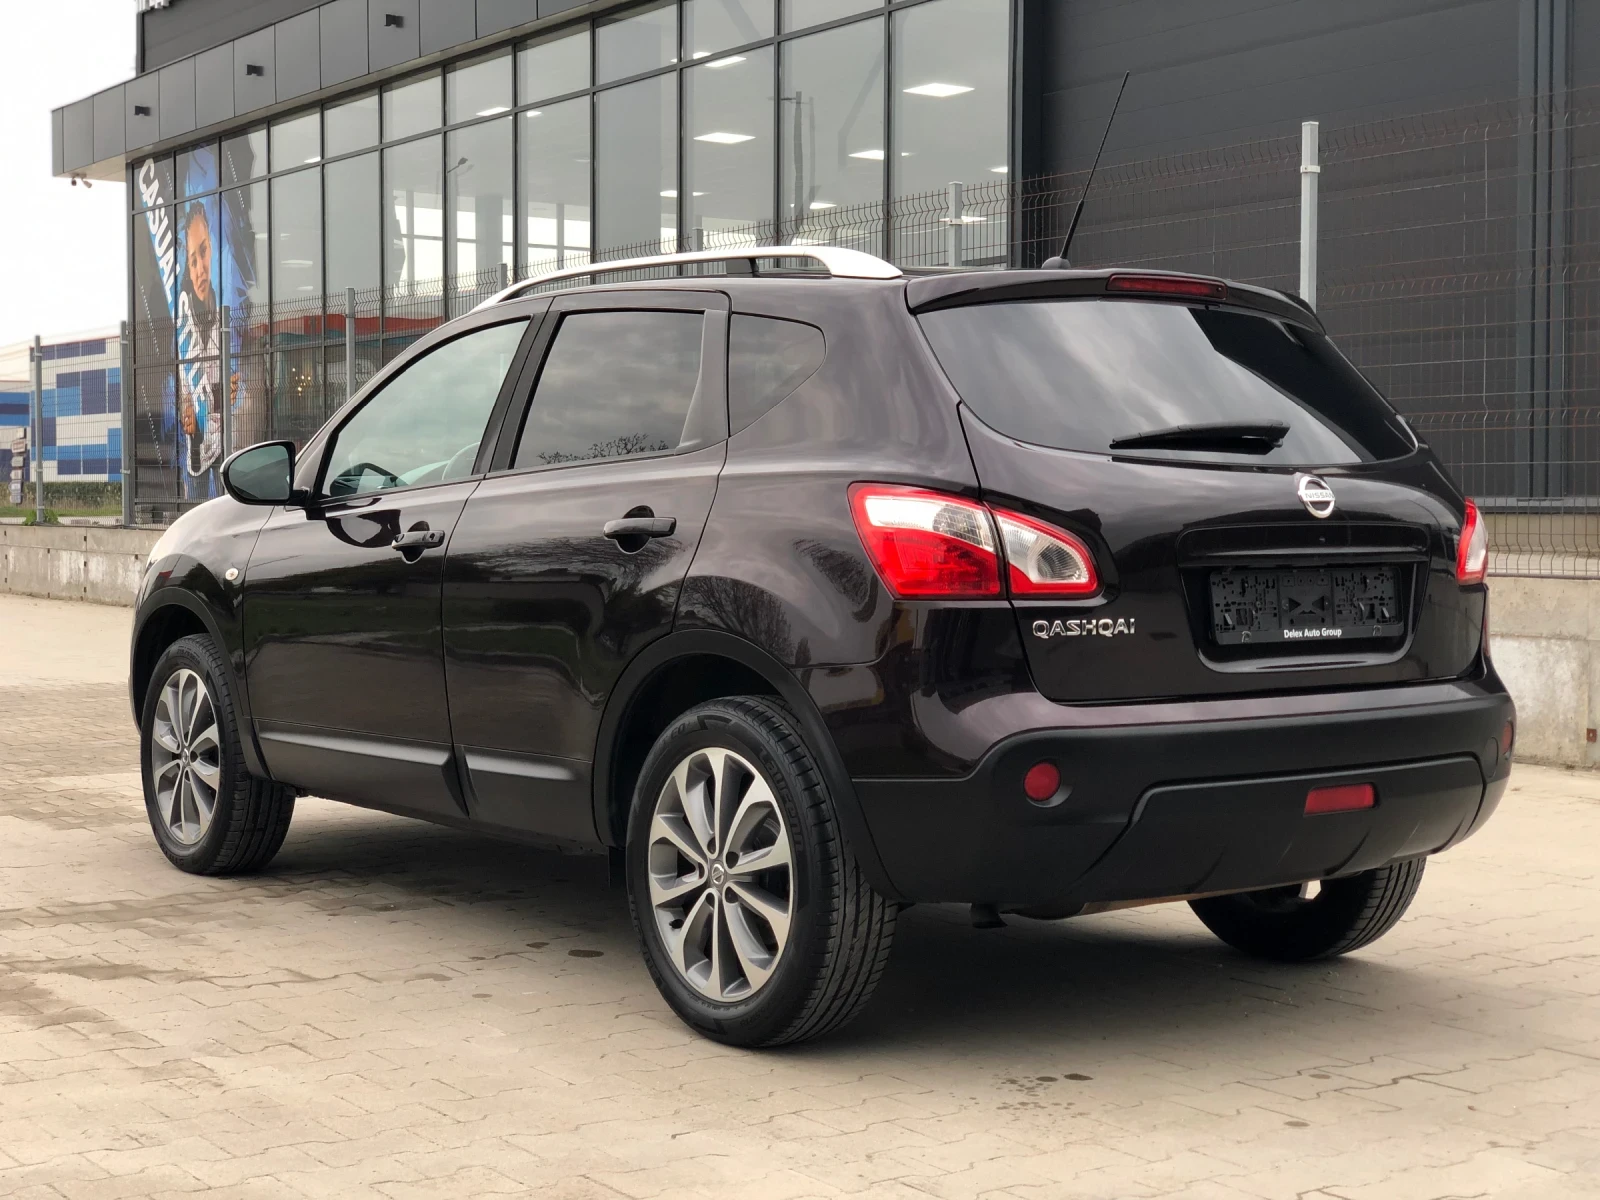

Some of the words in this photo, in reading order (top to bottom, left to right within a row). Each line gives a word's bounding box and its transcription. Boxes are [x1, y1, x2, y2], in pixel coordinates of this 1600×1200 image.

[139, 158, 180, 304] CASUAL
[173, 291, 214, 414] STYLE
[1304, 491, 1335, 499] NISSAN
[1032, 618, 1135, 639] QASHQAI
[1283, 629, 1302, 639] Delex
[1304, 628, 1320, 637] Auto
[1322, 627, 1342, 638] Group
